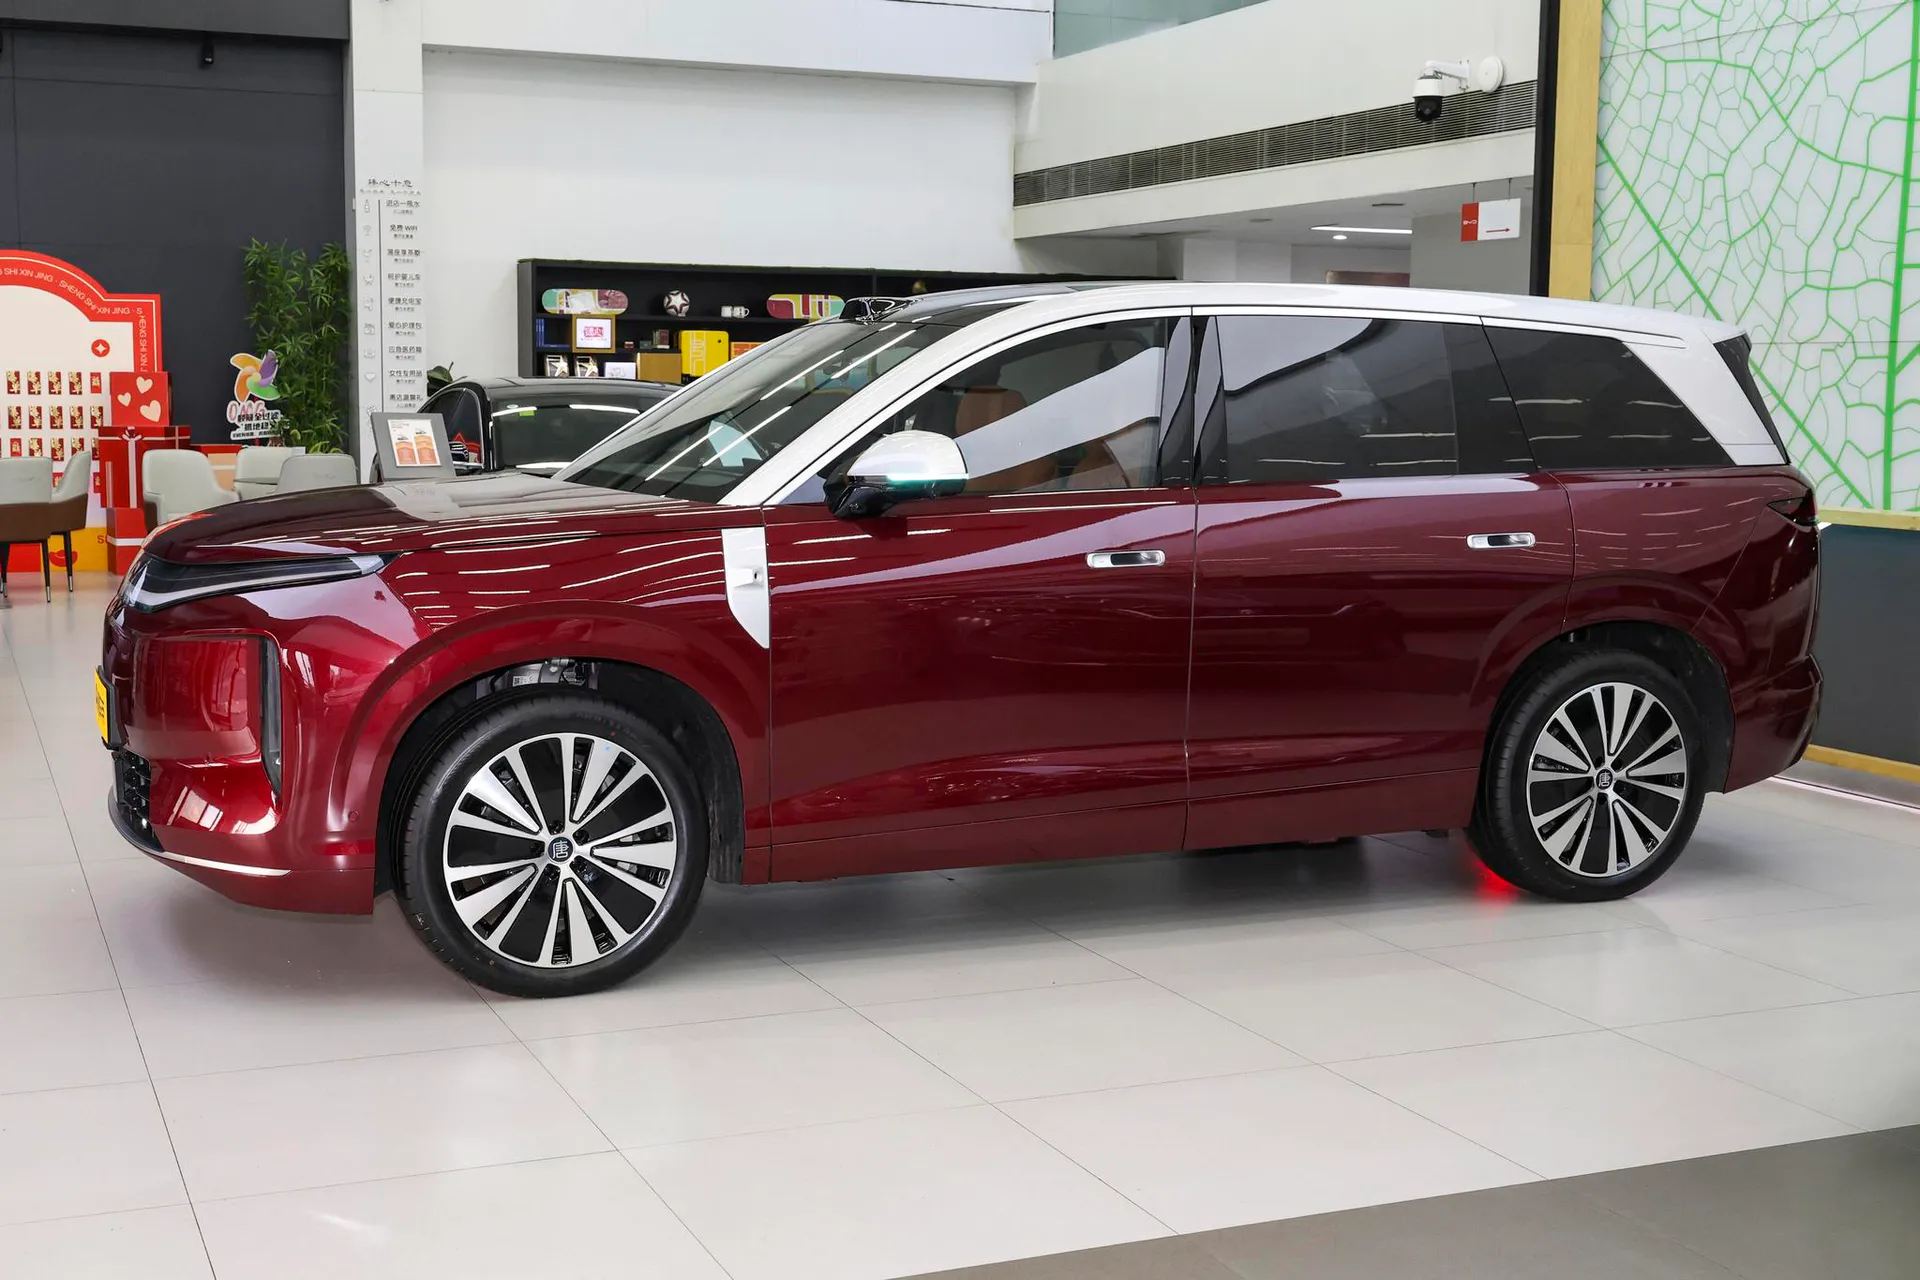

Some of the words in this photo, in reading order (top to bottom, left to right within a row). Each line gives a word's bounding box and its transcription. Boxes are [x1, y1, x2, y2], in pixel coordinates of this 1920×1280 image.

[3, 267, 18, 276] SHI
[19, 268, 34, 277] XIN
[34, 272, 54, 283] JING
[59, 280, 86, 300] SHENG
[96, 307, 111, 315] XIN
[112, 307, 130, 315] JING
